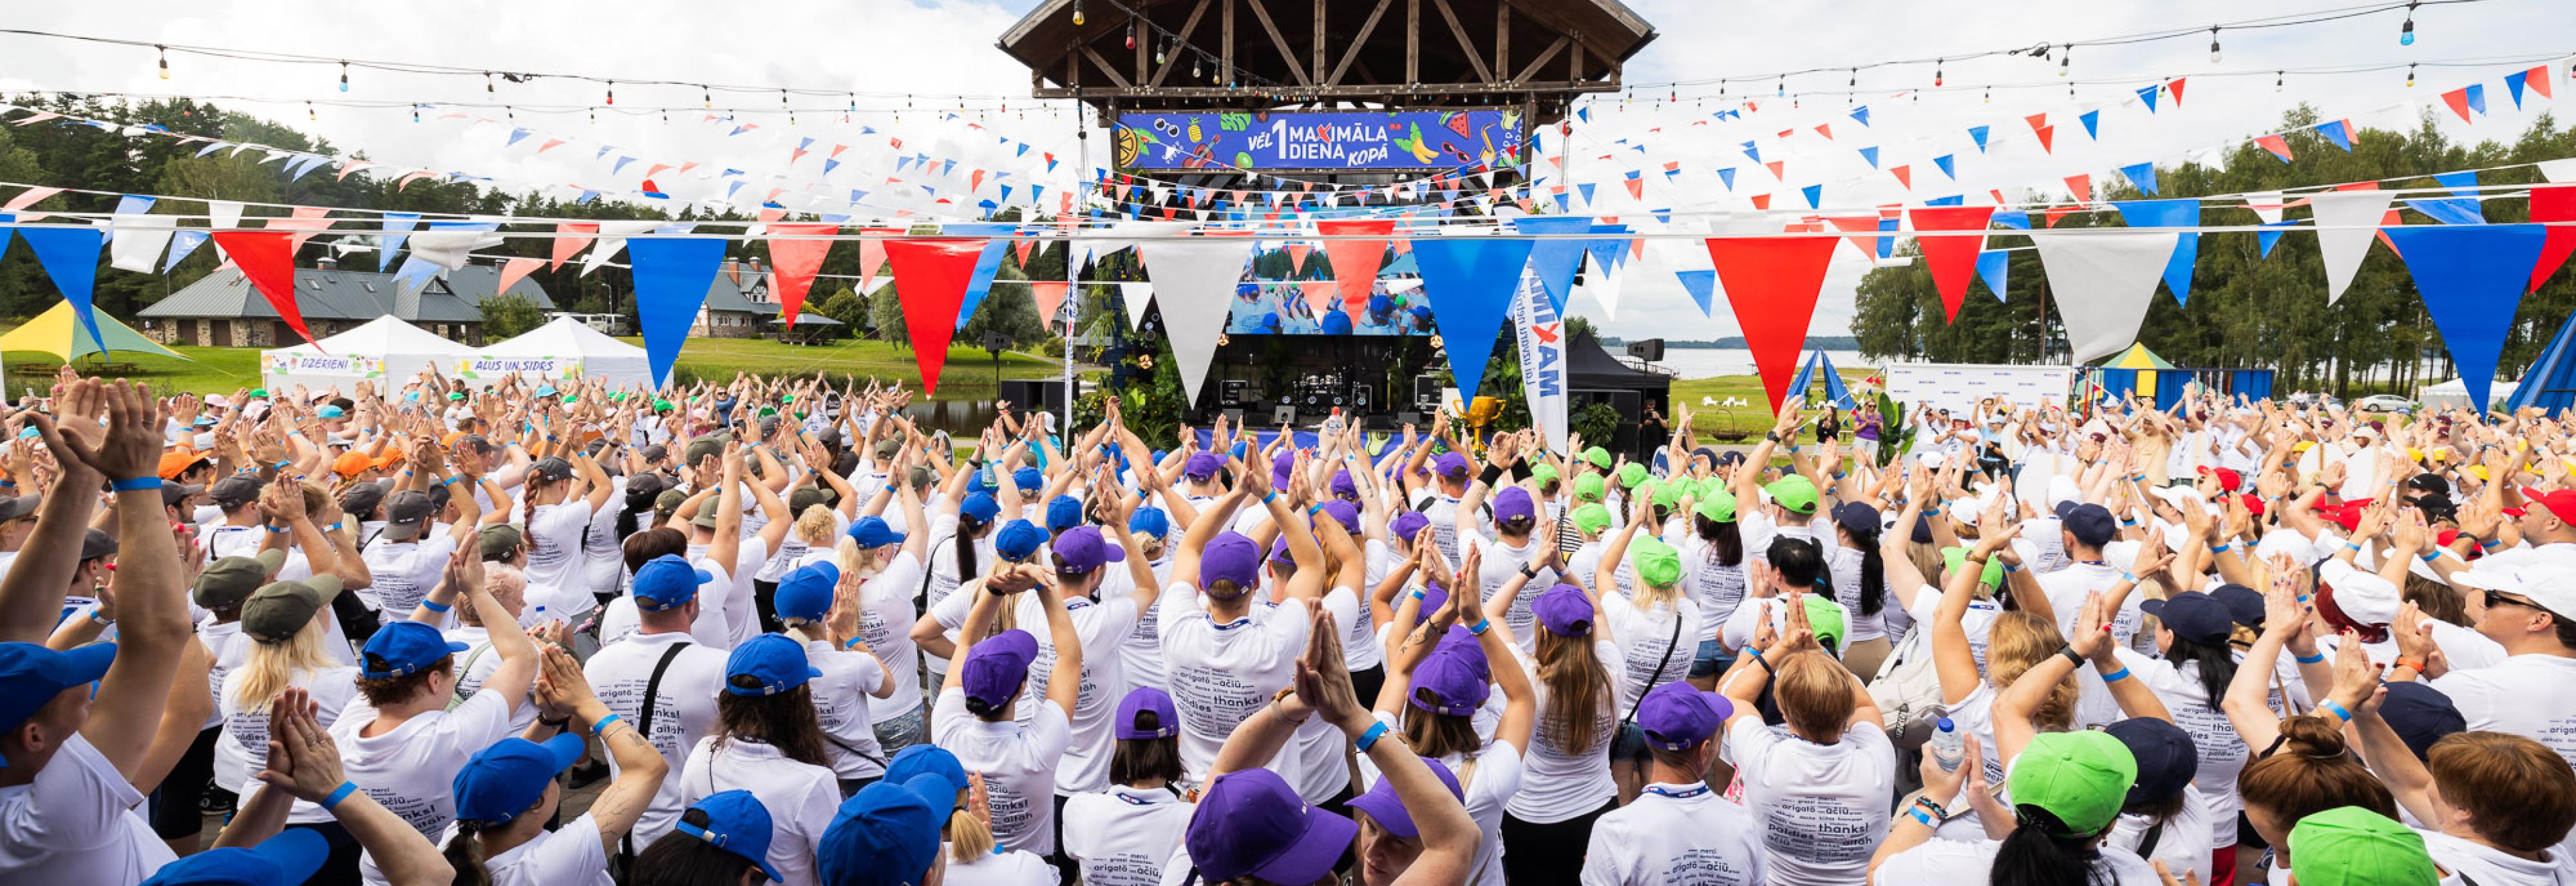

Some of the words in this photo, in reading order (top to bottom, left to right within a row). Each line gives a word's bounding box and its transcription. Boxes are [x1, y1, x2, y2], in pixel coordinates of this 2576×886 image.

[1272, 119, 1287, 159] 1
[1289, 122, 1388, 143] MAXIMĀLA
[1289, 144, 1345, 159] DIENA
[475, 360, 502, 371] ALUS
[504, 360, 519, 371] UN
[521, 360, 554, 371] SIDRS
[1214, 695, 1263, 707] thanks!
[1819, 823, 1868, 834] thanks!
